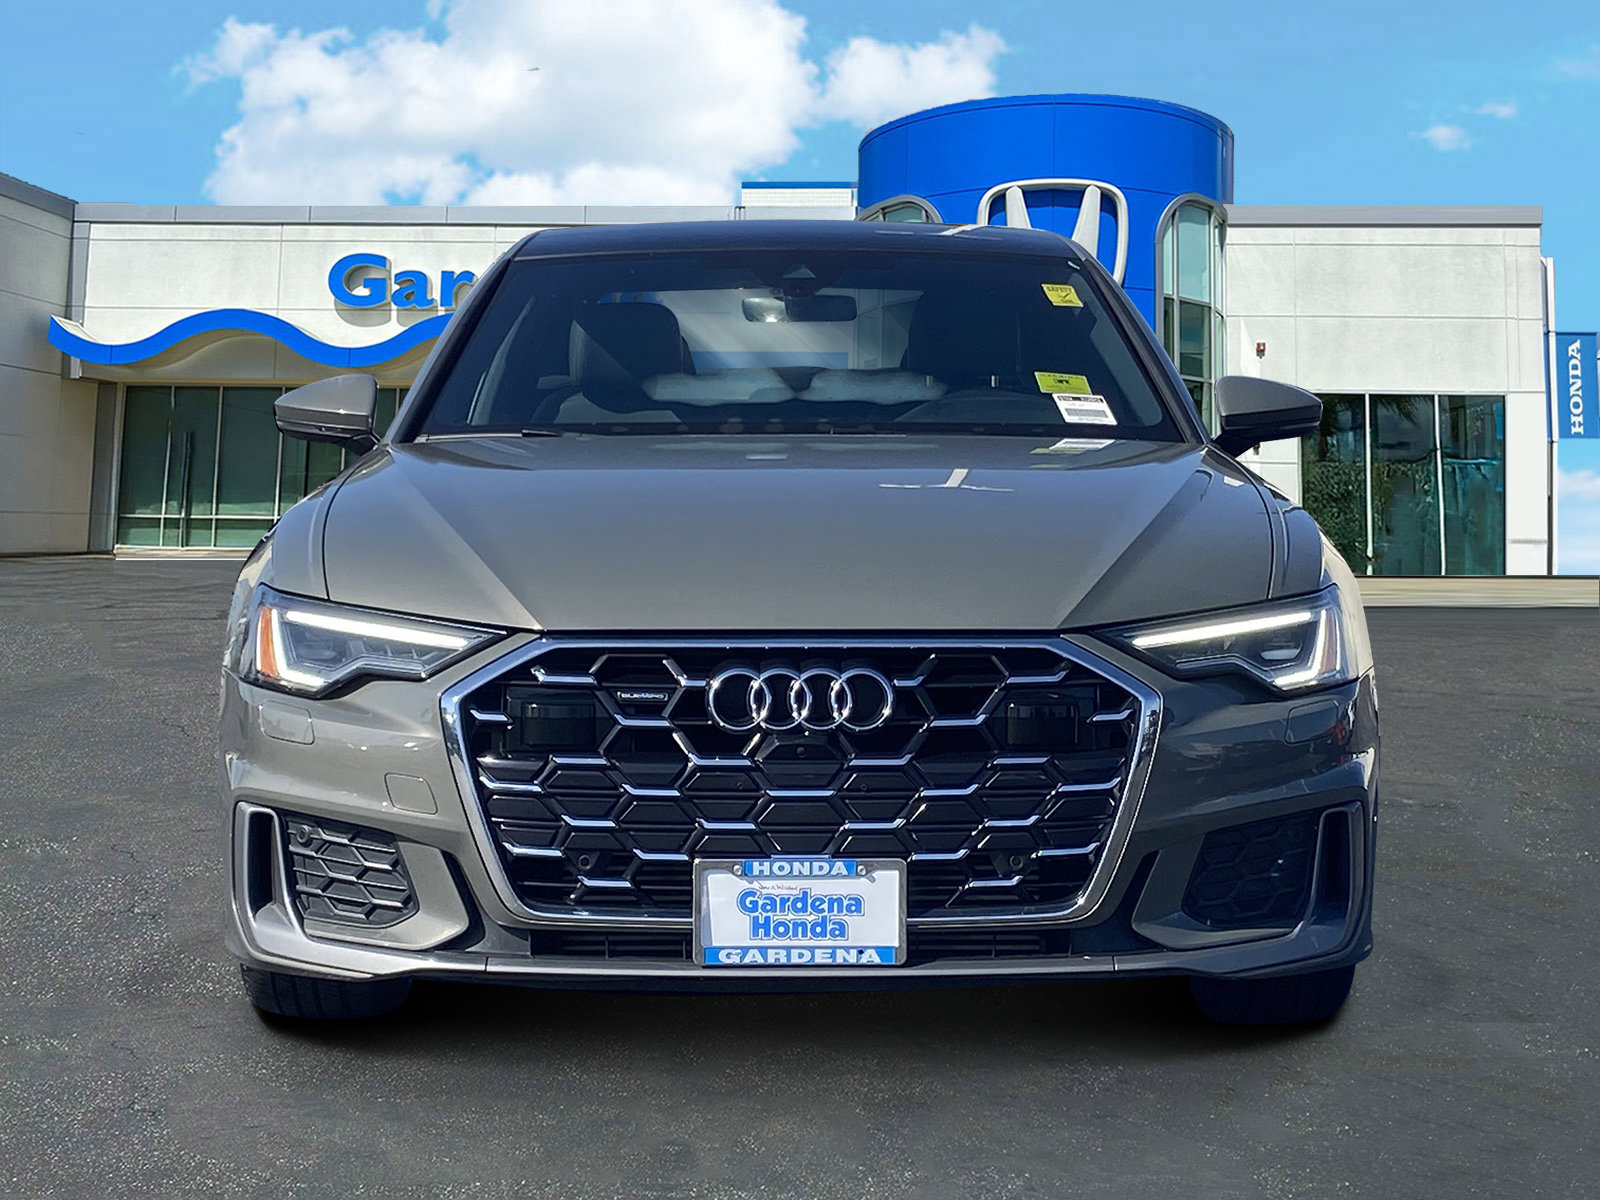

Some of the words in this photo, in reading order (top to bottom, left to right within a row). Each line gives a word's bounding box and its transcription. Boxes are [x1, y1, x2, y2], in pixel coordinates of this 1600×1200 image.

[1568, 339, 1584, 435] HONDA
[752, 861, 849, 876] HONDA
[738, 889, 863, 915] Gardena
[751, 914, 847, 939] Honda
[718, 949, 881, 964] GARDENA
